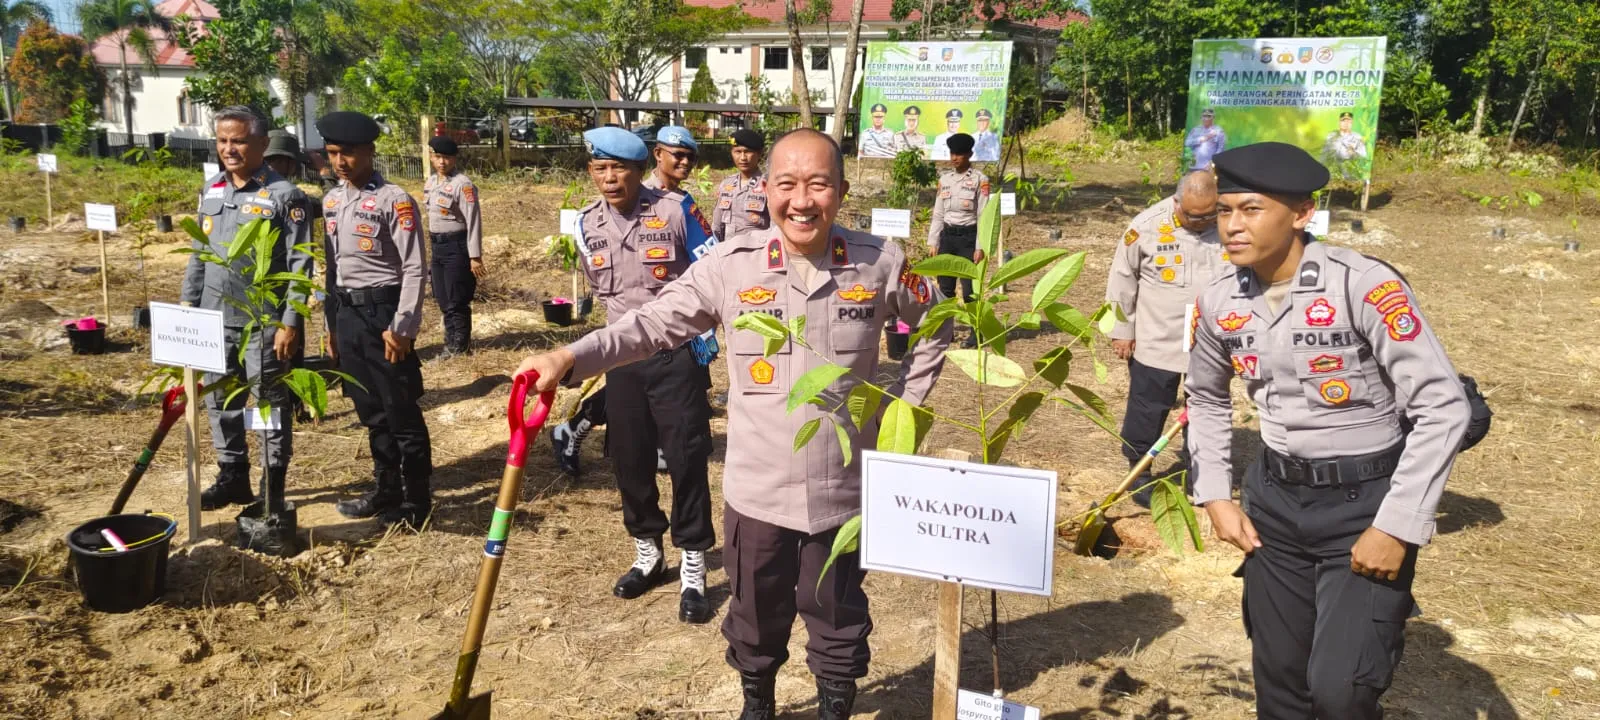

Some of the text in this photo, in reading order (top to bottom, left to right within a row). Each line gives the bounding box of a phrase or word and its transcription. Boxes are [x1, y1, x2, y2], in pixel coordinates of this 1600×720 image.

[916, 63, 933, 72] KAB.
[936, 63, 968, 72] KONAWE
[971, 63, 1005, 72] SELATAN
[1195, 70, 1381, 85] PENANAMAN POHON
[1206, 90, 1235, 98] DALAM
[1237, 90, 1273, 98] RANGKA
[1275, 90, 1332, 98] PERINGATAN
[1209, 98, 1355, 106] HARI BHAYANGKARA TAHUN 2024
[354, 211, 381, 222] POLRI
[638, 232, 671, 242] POLRI
[1156, 243, 1180, 252] BENY
[838, 307, 874, 319] POLRI
[175, 326, 199, 336] BUPATI
[157, 333, 219, 349] KONAWE SELATAN
[1293, 331, 1352, 346] POLRI
[894, 495, 1018, 524] WAKAPOLDA
[917, 521, 991, 545] SULTRA
[974, 698, 992, 709] Gito
